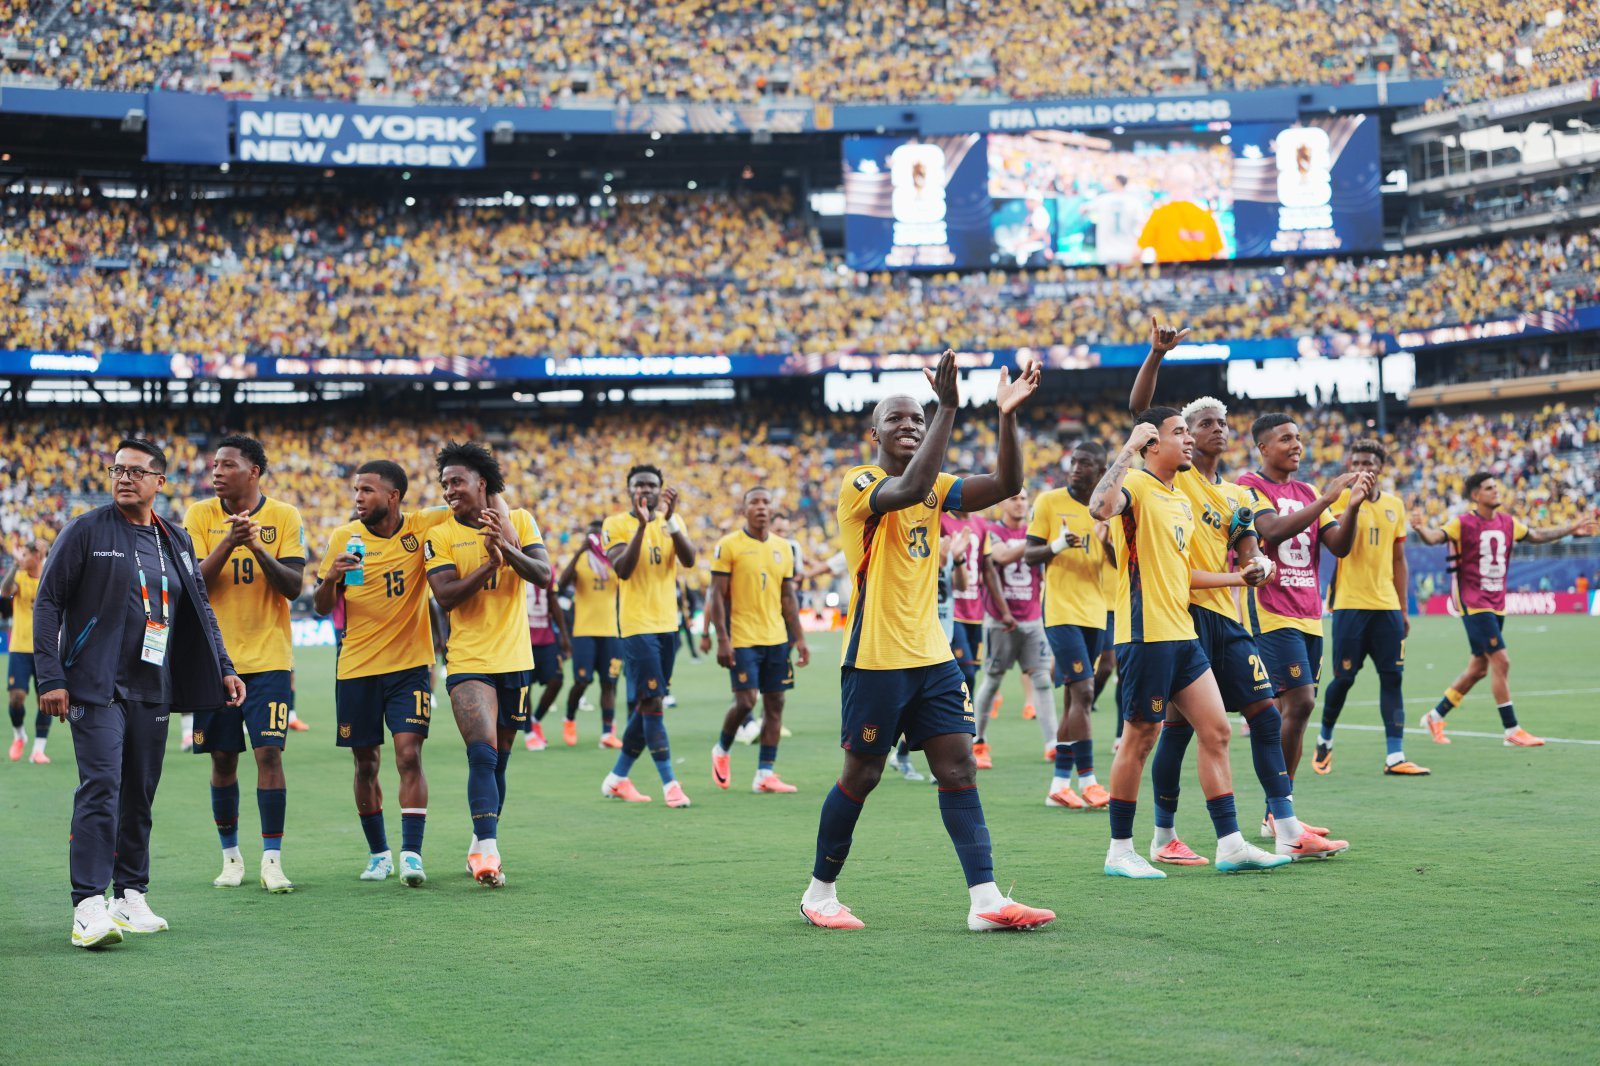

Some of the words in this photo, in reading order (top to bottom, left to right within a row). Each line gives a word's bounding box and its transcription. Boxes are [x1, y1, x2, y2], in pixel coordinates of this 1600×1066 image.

[240, 111, 345, 139] NEW
[352, 114, 477, 142] YORK
[989, 109, 1036, 129] FIFA
[1036, 105, 1111, 127] WORLD
[1112, 103, 1155, 123] CUP
[1157, 100, 1231, 121] 2026
[240, 140, 326, 163] NEW
[331, 143, 477, 167] JERSEY
[649, 546, 662, 565] 16
[908, 526, 931, 558] 23
[231, 557, 254, 585] 19
[383, 569, 405, 598] 15
[1280, 575, 1316, 587] 2026
[268, 701, 288, 730] 19
[413, 690, 430, 718] 15
